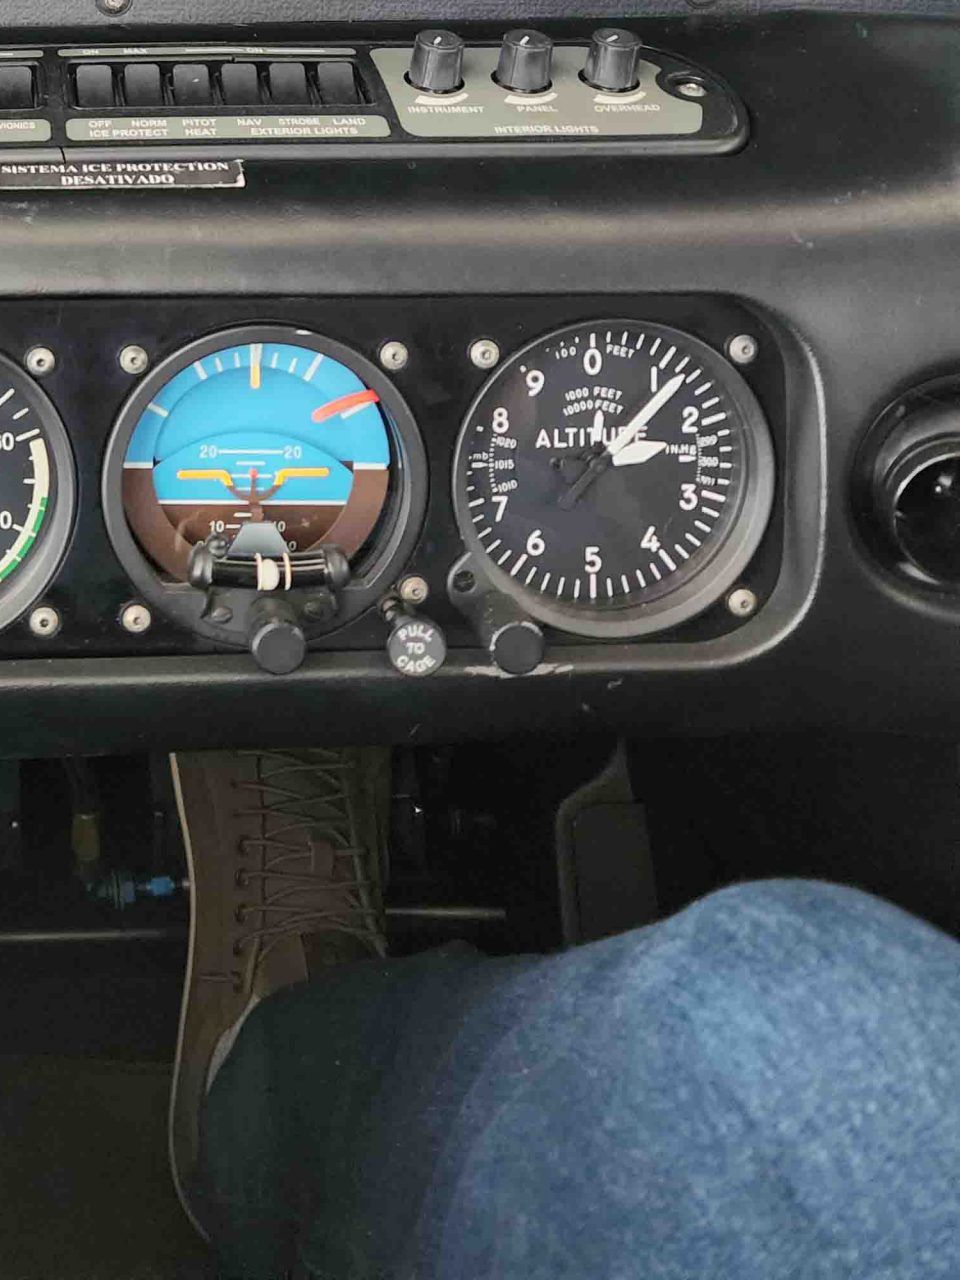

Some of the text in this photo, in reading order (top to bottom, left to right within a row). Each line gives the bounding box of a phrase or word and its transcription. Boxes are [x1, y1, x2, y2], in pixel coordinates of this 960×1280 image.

[407, 105, 485, 114] INSTRUMENT
[516, 105, 558, 113] PANEL
[594, 103, 661, 112] OVERHEAD
[88, 120, 112, 128] OFF
[131, 119, 167, 127] NORM
[182, 118, 217, 126] PITOT
[237, 118, 262, 126] NAV
[90, 129, 168, 137] ICE PROTECT
[185, 128, 217, 136] HEAT
[251, 127, 358, 136] EXTERIOR LIGHTS
[494, 124, 599, 135] INTERIOR LIGHTS
[1, 161, 229, 174] SISTEMA ICE PROTECTION
[60, 174, 176, 186] DESATIVADO
[555, 346, 576, 359] 100
[606, 343, 635, 358] FEET
[583, 348, 602, 375] 0
[526, 369, 545, 397] 9
[565, 386, 623, 401] 1000 FEET
[563, 399, 624, 416] 10000 FEET
[492, 407, 509, 434] 8
[682, 406, 699, 433] 2
[496, 436, 517, 449] 1020
[199, 445, 302, 459] 20 20
[473, 452, 489, 461] mb
[494, 459, 515, 470] 1015
[498, 480, 518, 493] 1010
[679, 483, 698, 511] 3
[491, 496, 509, 522] 7
[210, 521, 225, 532] 10
[526, 529, 545, 556] 6
[640, 525, 661, 553] 4
[584, 546, 602, 573] 5
[398, 625, 434, 642] PULL
[406, 642, 425, 655] TO
[397, 655, 436, 673] CAGE
